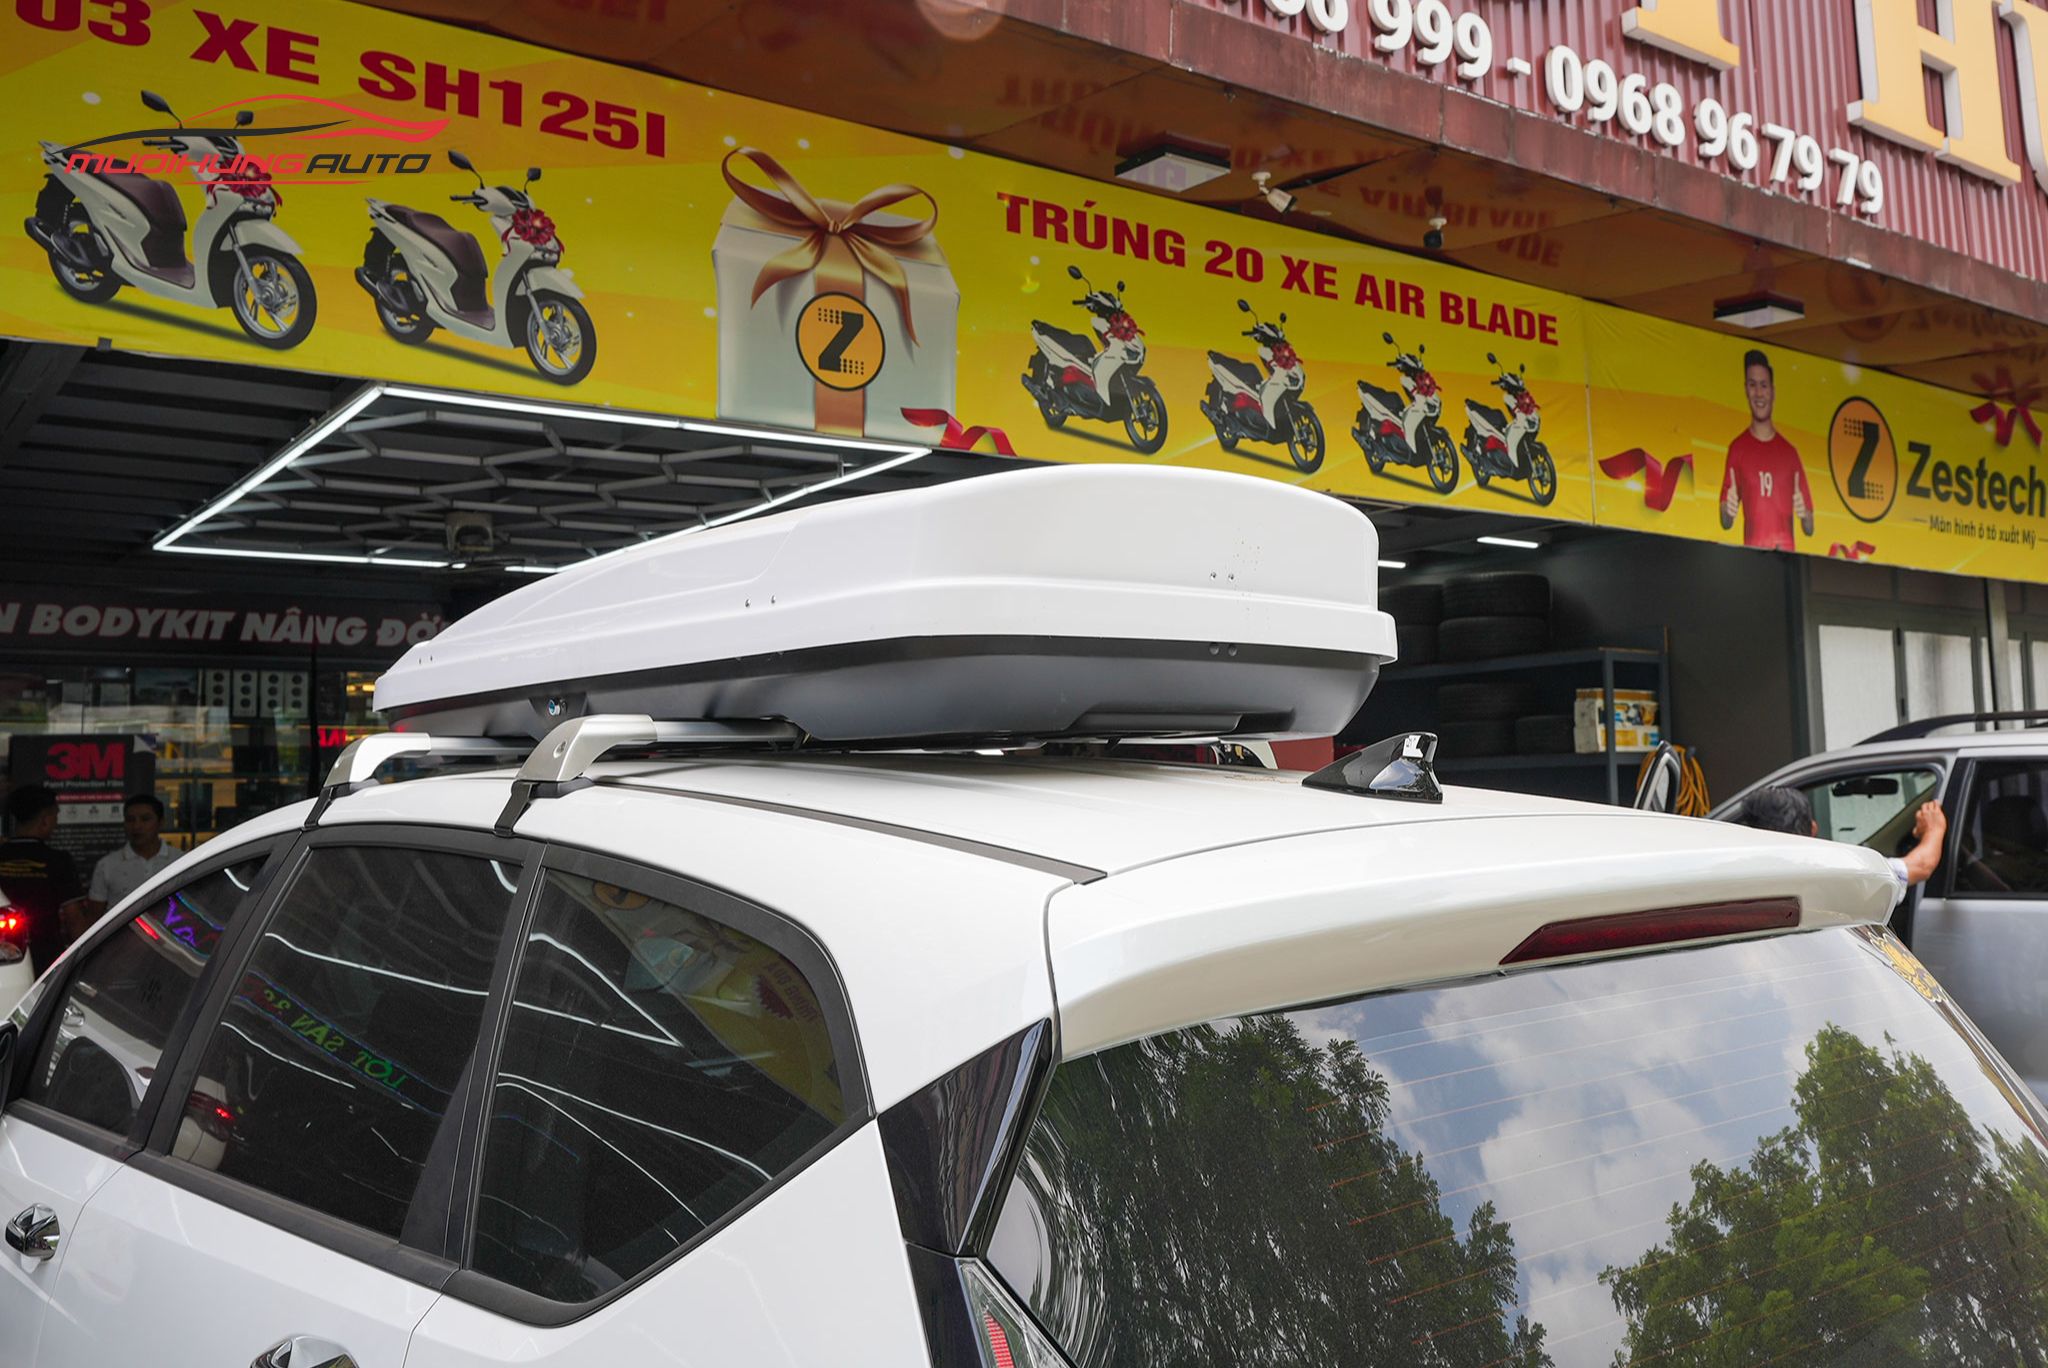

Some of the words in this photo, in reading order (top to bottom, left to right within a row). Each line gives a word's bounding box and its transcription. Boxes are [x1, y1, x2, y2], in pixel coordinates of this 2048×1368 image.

[16, 0, 151, 46] 03
[189, 9, 320, 85] XE
[358, 50, 665, 158] SH125I
[1369, 0, 1493, 80] 999
[1544, 45, 1686, 147] 0968
[1693, 98, 1760, 171] 96
[1761, 122, 1824, 191] 79
[1828, 147, 1884, 214] 79
[997, 192, 1187, 268] TRÚNG
[1204, 239, 1264, 283] 20
[1280, 255, 1339, 300] XE
[1354, 273, 1426, 319] AIR
[1440, 290, 1560, 346] BLADE
[1758, 470, 1774, 497] 19
[1906, 440, 2047, 518] Zestech
[29, 604, 236, 640] BODYKIT
[240, 597, 368, 646] NÂNG
[46, 742, 126, 780] 3M
